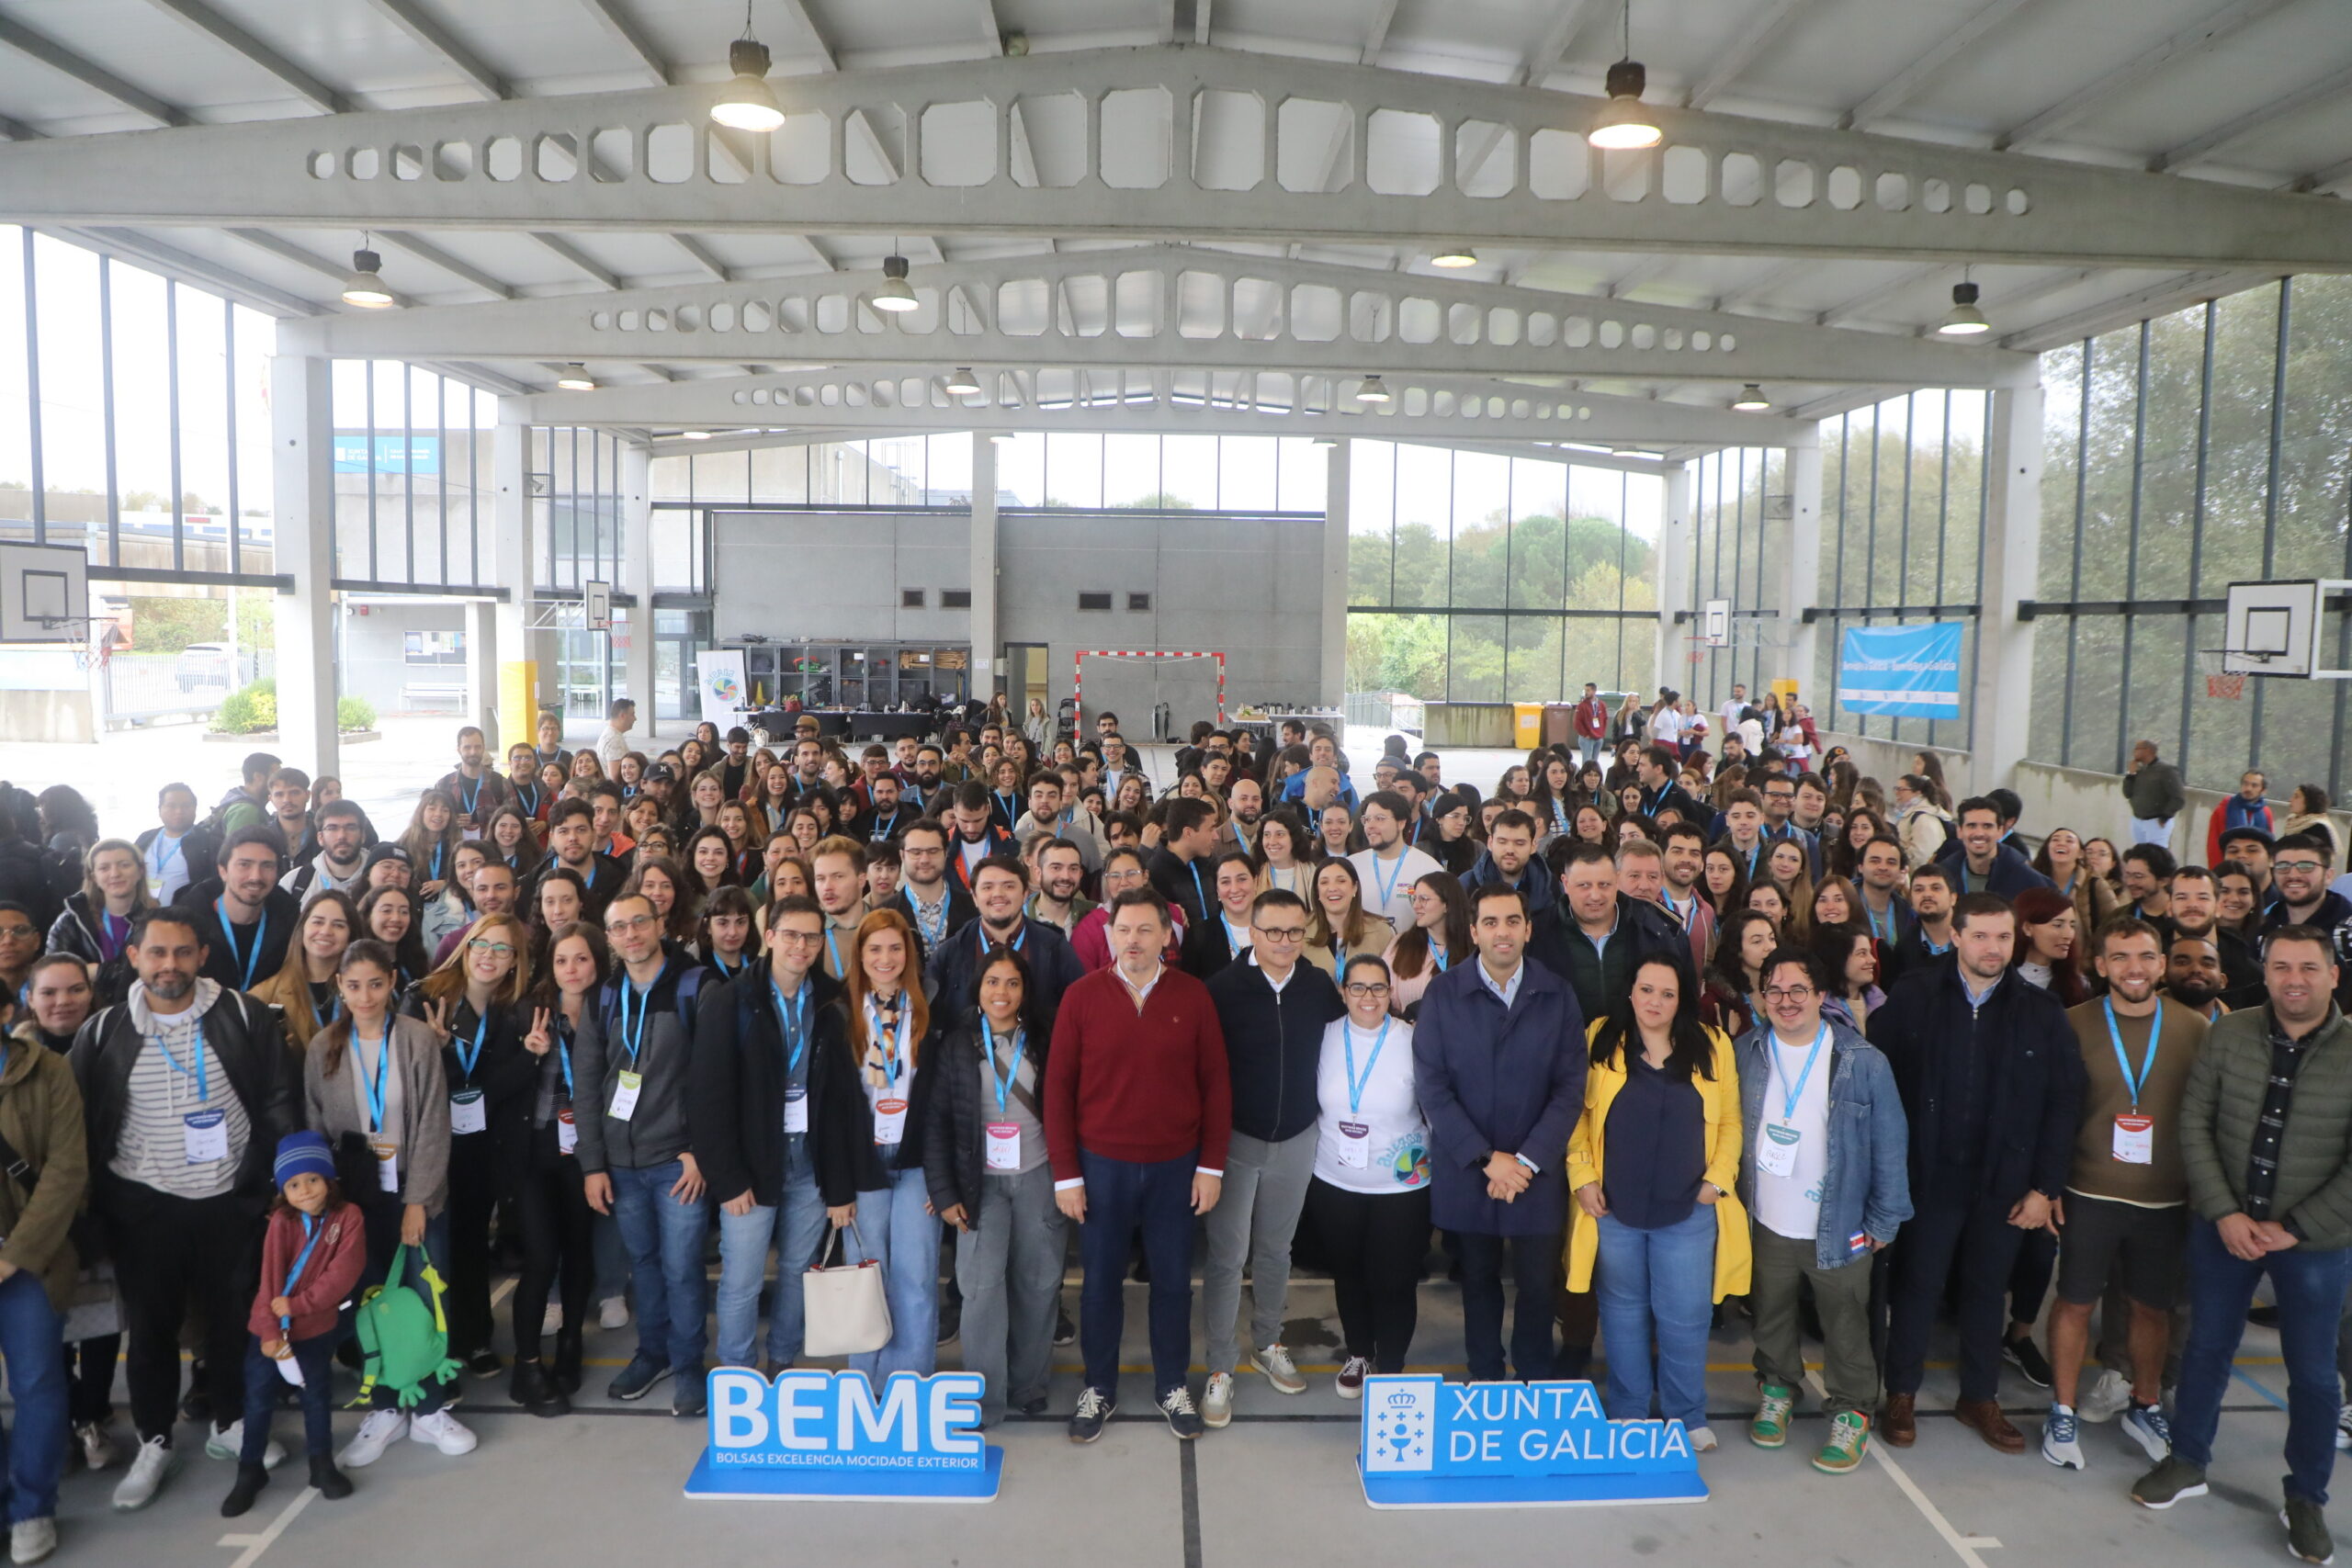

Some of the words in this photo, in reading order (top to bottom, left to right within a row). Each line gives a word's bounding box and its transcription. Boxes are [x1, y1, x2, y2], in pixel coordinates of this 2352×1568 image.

[713, 1373, 980, 1453] BEME
[1453, 1388, 1600, 1421] XUNTA
[717, 1452, 764, 1464] BOLSAS
[767, 1453, 843, 1466] EXCELENCIA
[846, 1454, 914, 1467] MOCIDADE
[918, 1456, 979, 1469] EXTERIOR
[1450, 1429, 1503, 1461] DE
[1519, 1427, 1689, 1461] GALICIA
